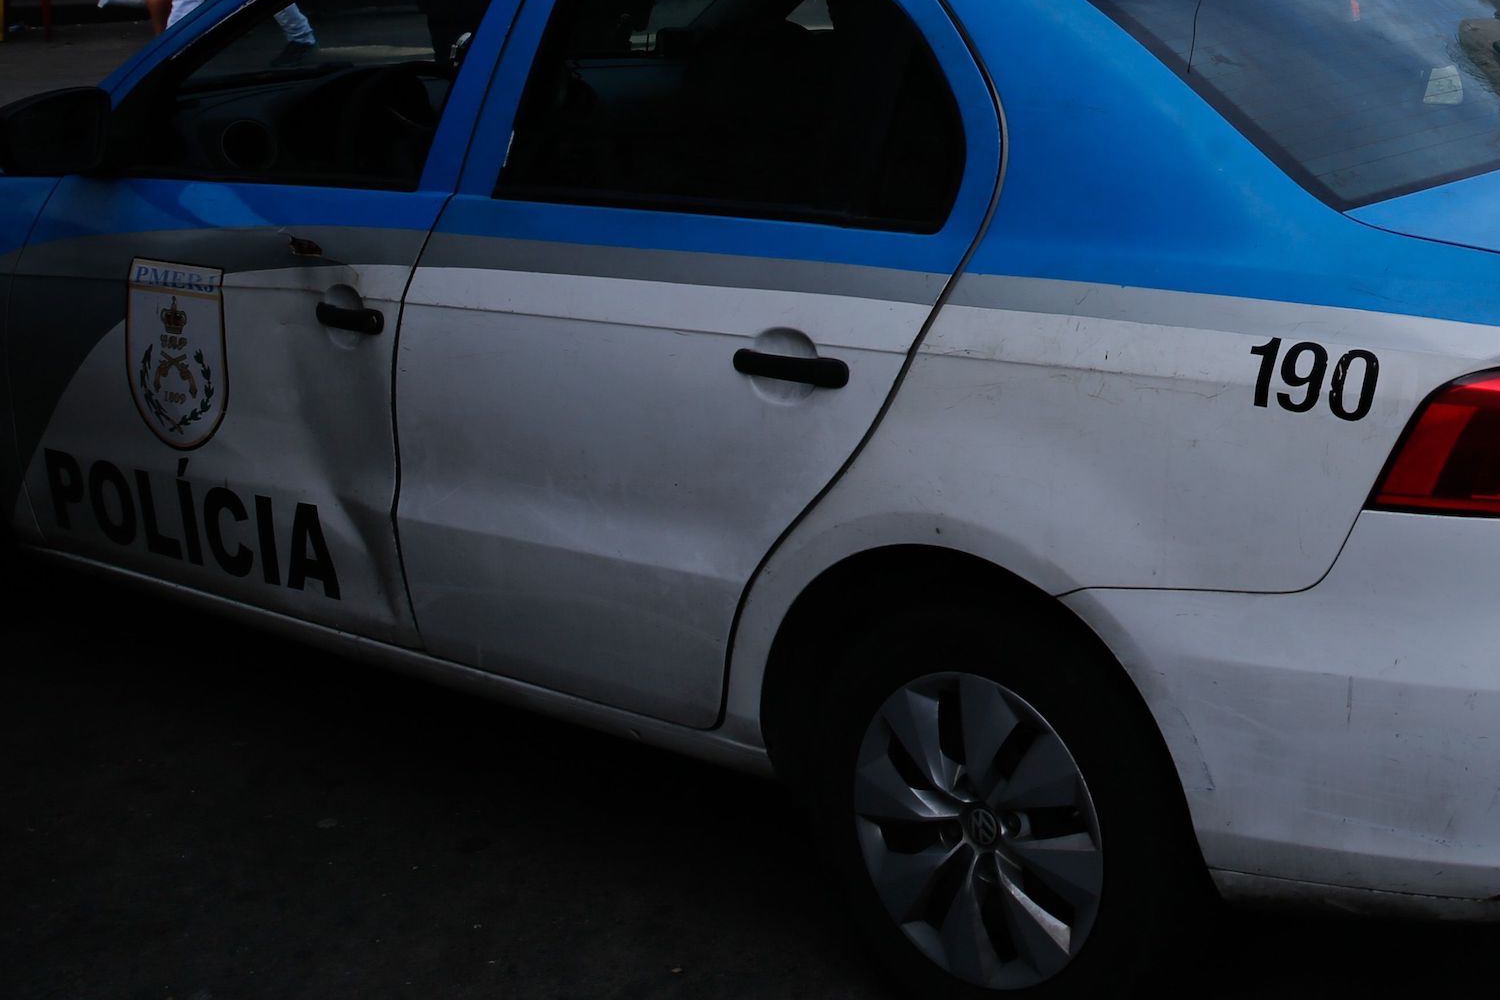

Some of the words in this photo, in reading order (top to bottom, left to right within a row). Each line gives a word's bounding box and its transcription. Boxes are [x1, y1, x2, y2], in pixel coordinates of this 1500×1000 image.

[135, 264, 216, 293] PMERJ
[1250, 337, 1380, 421] 190
[44, 447, 341, 601] POLÍCIA
